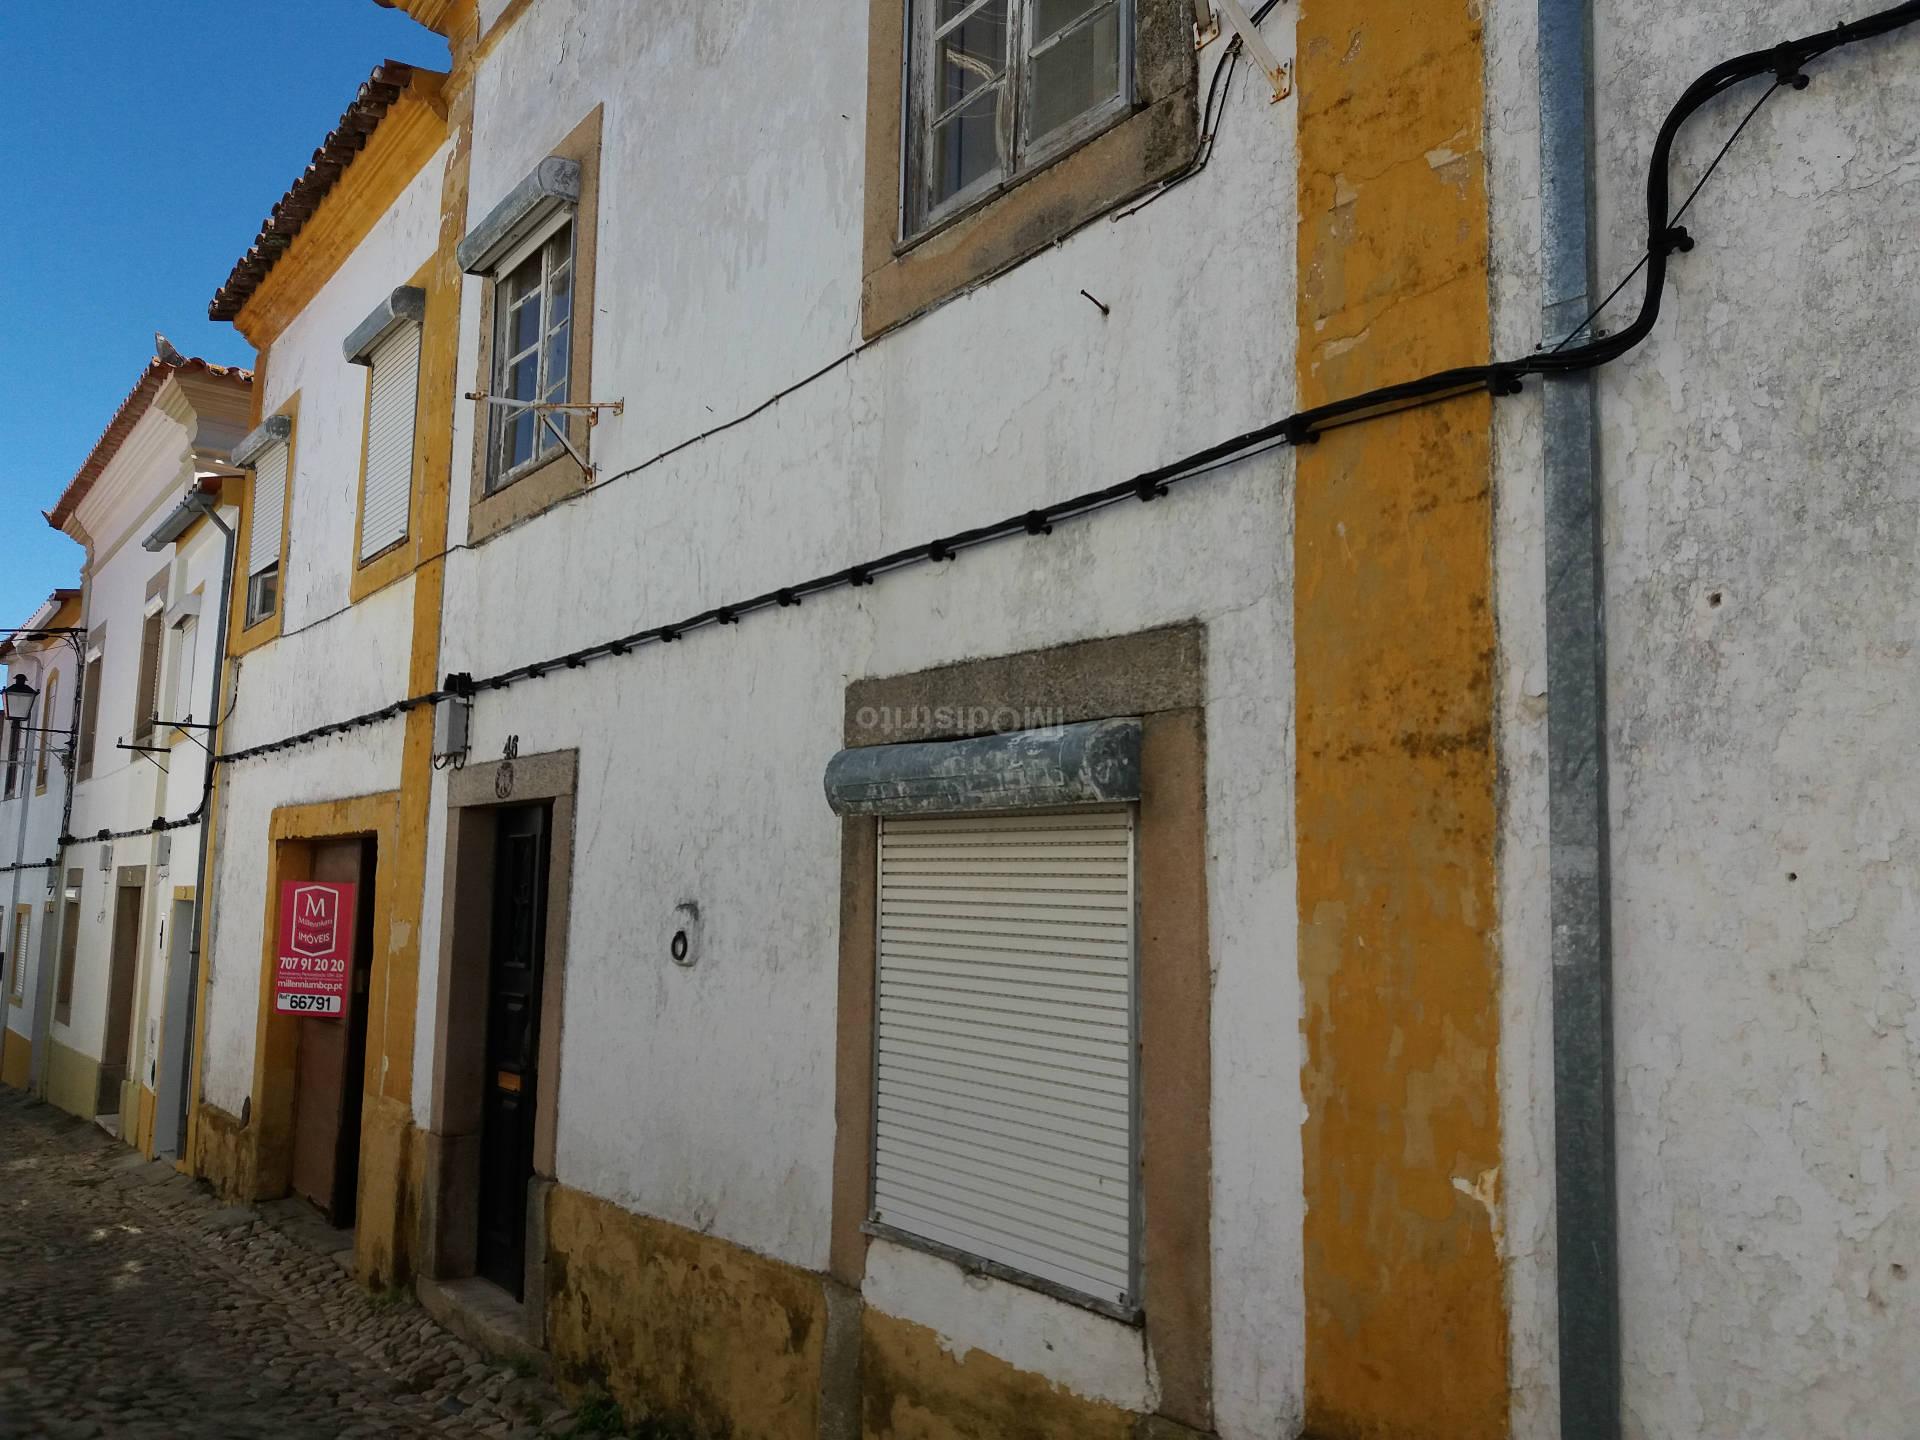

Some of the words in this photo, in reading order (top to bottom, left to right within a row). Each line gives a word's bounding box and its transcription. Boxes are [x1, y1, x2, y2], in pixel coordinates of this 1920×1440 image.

[502, 734, 519, 760] 46
[305, 893, 326, 917] M
[298, 932, 330, 944] IMÓVEIS
[279, 957, 299, 970] 707
[300, 958, 312, 971] 91
[313, 959, 329, 972] 20
[330, 959, 345, 972] 20
[277, 979, 343, 992] millenniumbcp.pt
[289, 995, 332, 1011] 66791
